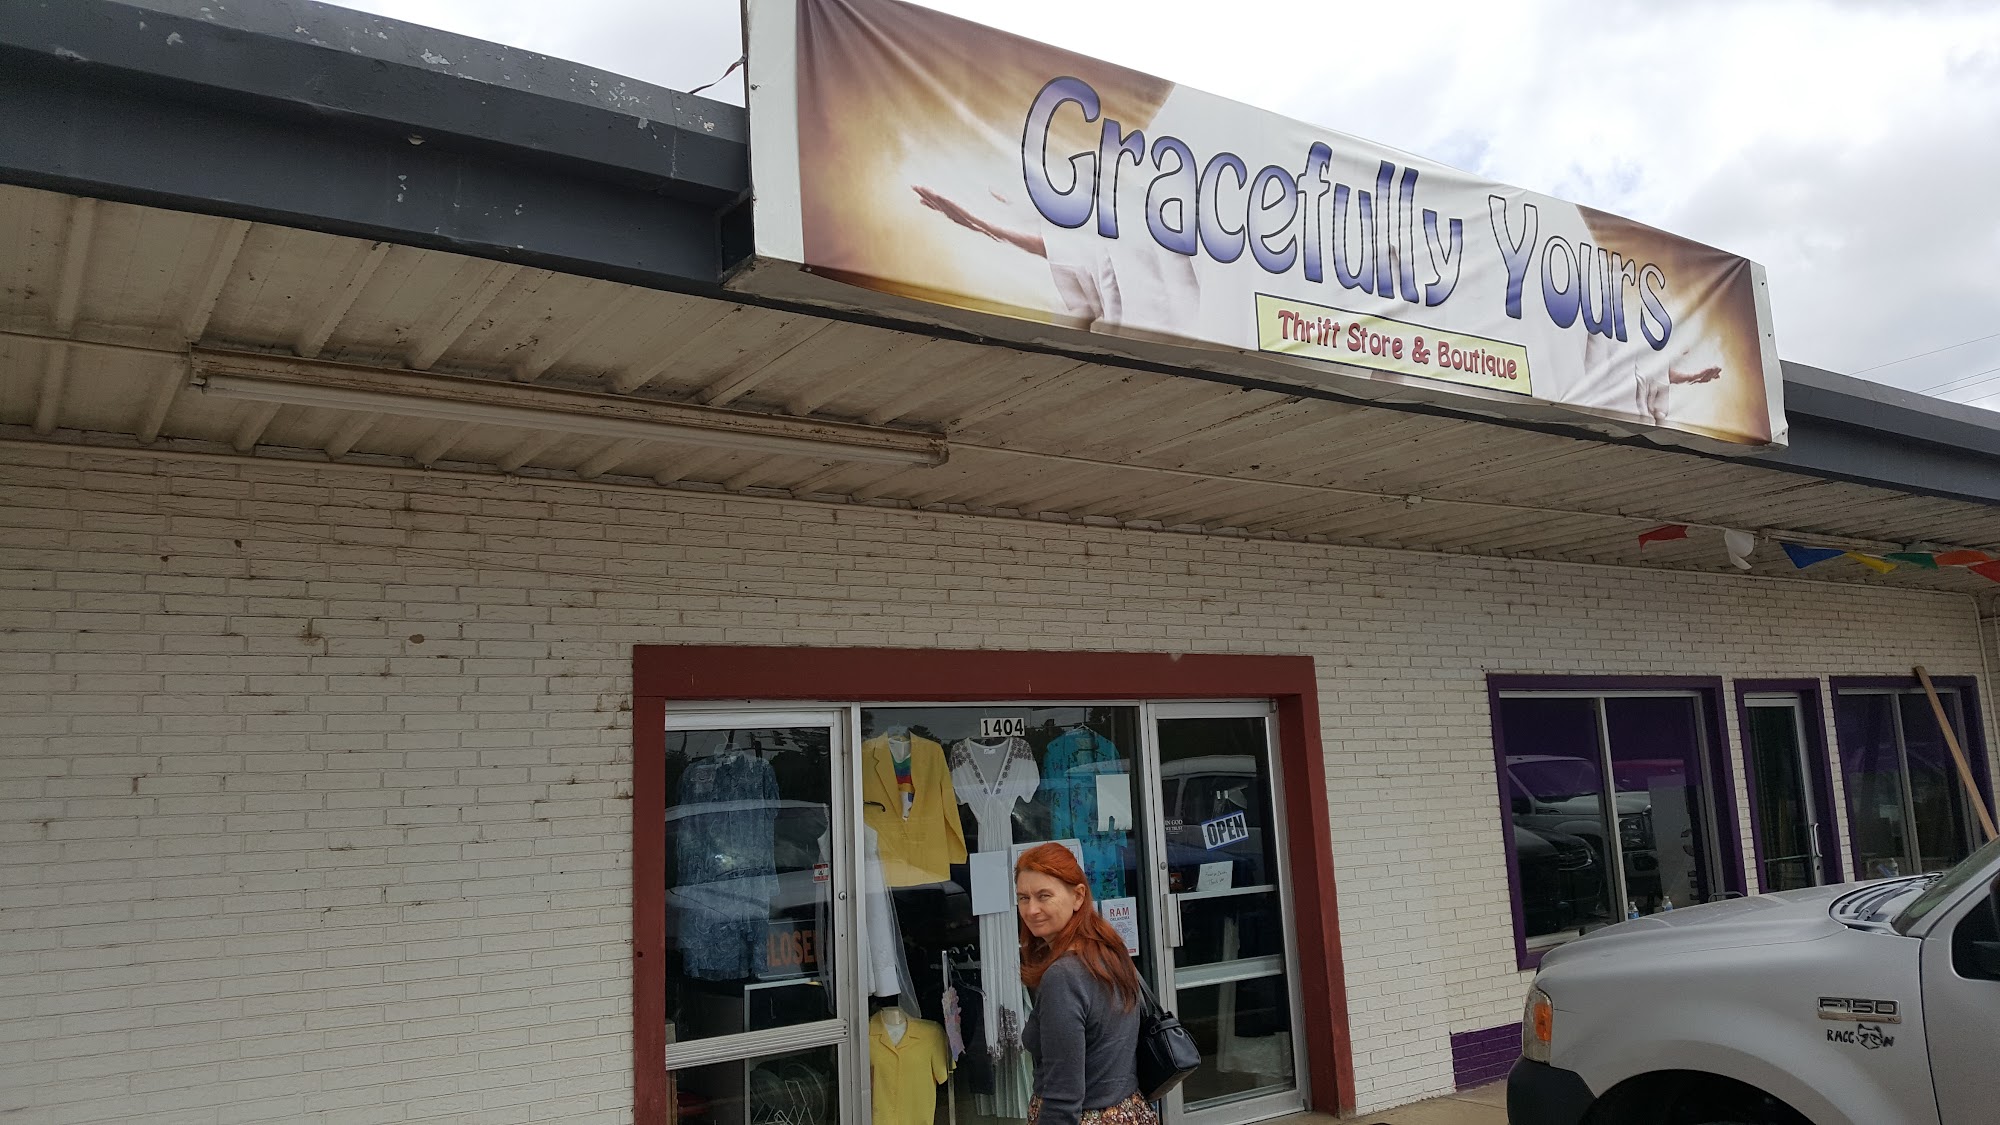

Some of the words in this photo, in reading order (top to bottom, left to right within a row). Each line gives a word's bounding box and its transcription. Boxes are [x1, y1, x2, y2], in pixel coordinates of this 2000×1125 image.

[1021, 75, 1463, 307] Gracefully
[1488, 194, 1673, 351] Yours
[1278, 310, 1340, 348] Thrift
[1347, 322, 1403, 360] Store
[1411, 336, 1431, 365] &
[1437, 341, 1518, 380] Boutique
[983, 718, 1024, 736] 1404
[1206, 814, 1246, 846] OPEN
[1109, 907, 1130, 917] RAM
[766, 930, 817, 967] LOSE
